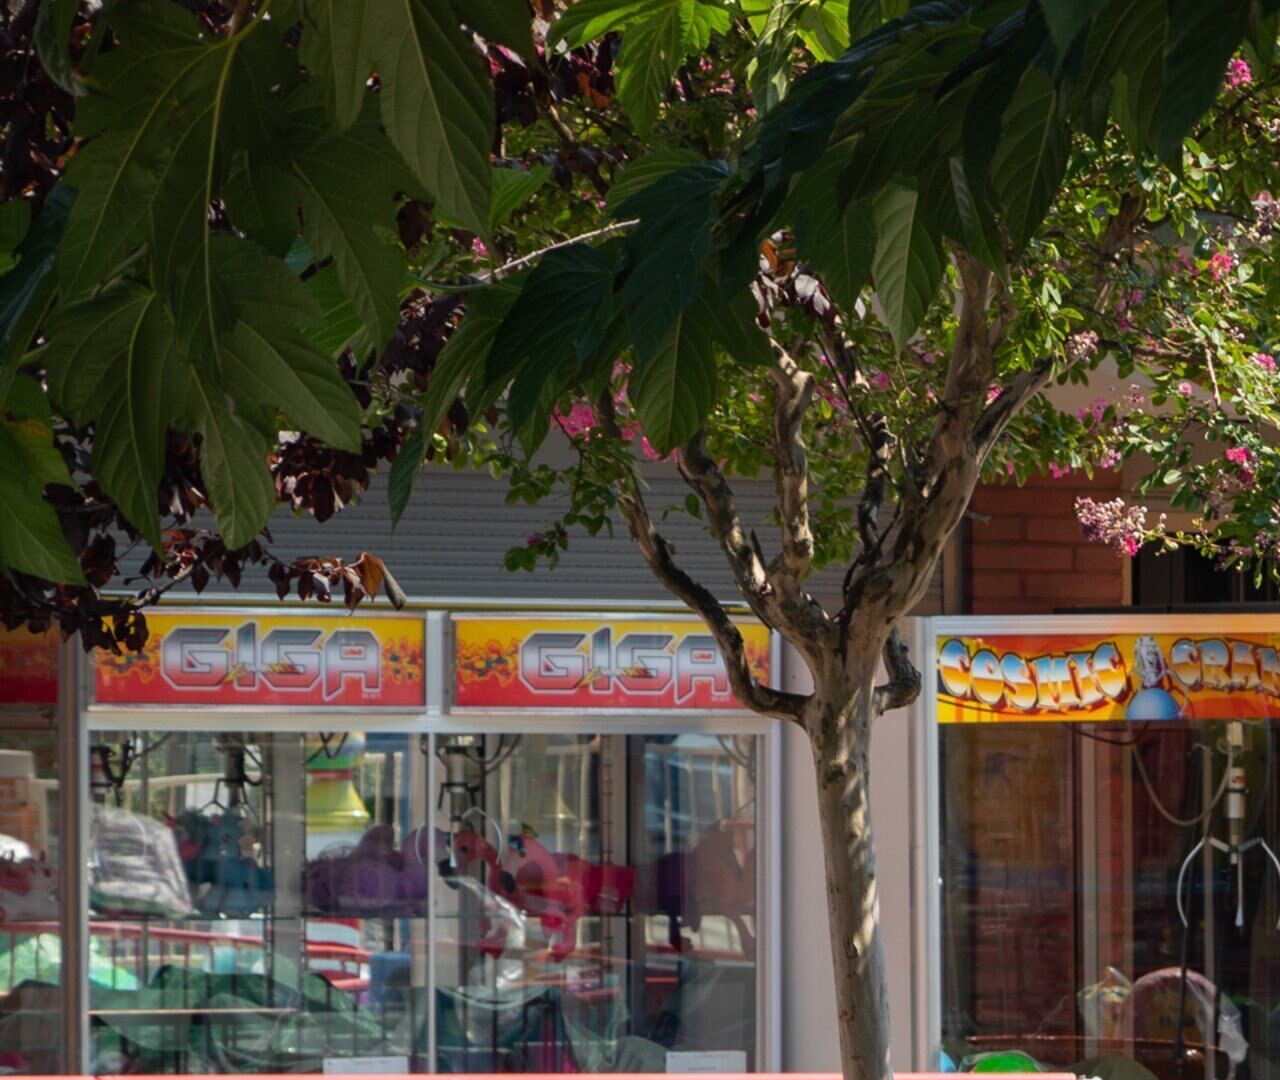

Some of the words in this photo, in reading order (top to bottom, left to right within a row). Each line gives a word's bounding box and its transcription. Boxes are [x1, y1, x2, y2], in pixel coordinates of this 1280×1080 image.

[161, 621, 382, 701] GIGA
[518, 625, 736, 705] GIGA
[937, 638, 1128, 713] COSMIC
